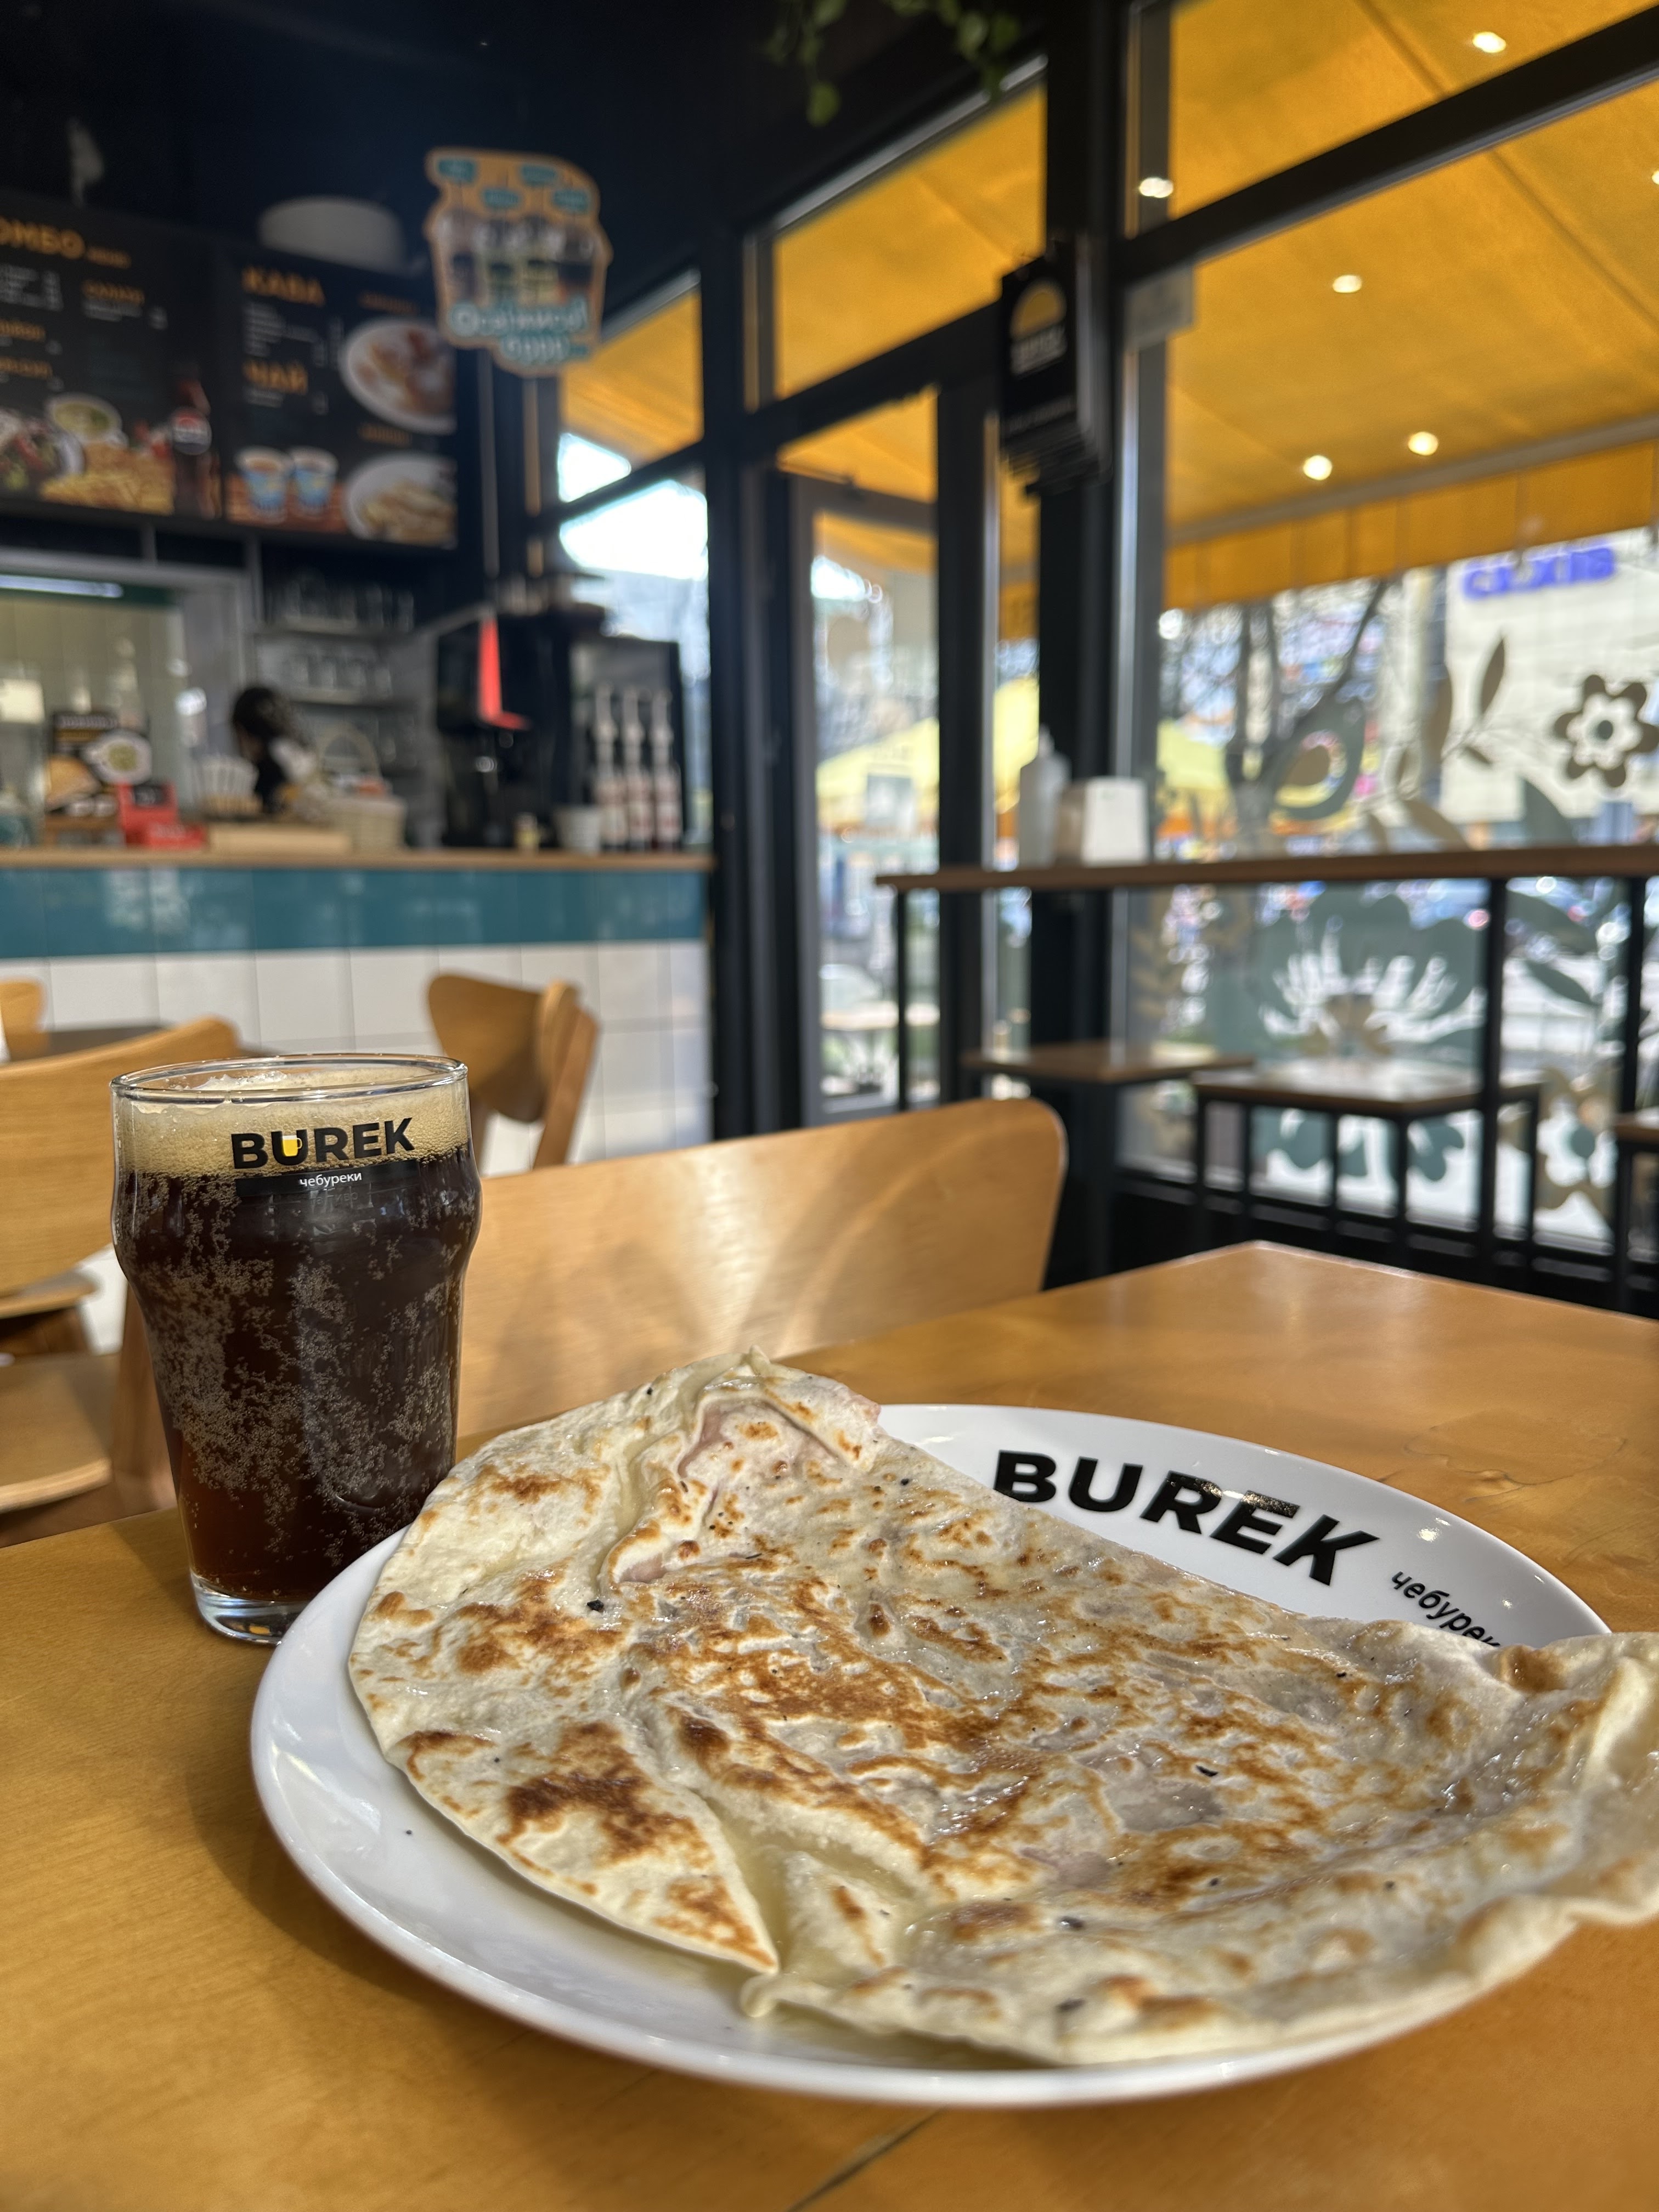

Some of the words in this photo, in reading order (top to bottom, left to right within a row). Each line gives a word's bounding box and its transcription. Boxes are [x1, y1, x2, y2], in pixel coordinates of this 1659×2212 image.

[231, 1117, 415, 1169] BUREK
[300, 1172, 362, 1187] чебуреки
[993, 1449, 1380, 1586] BUREK
